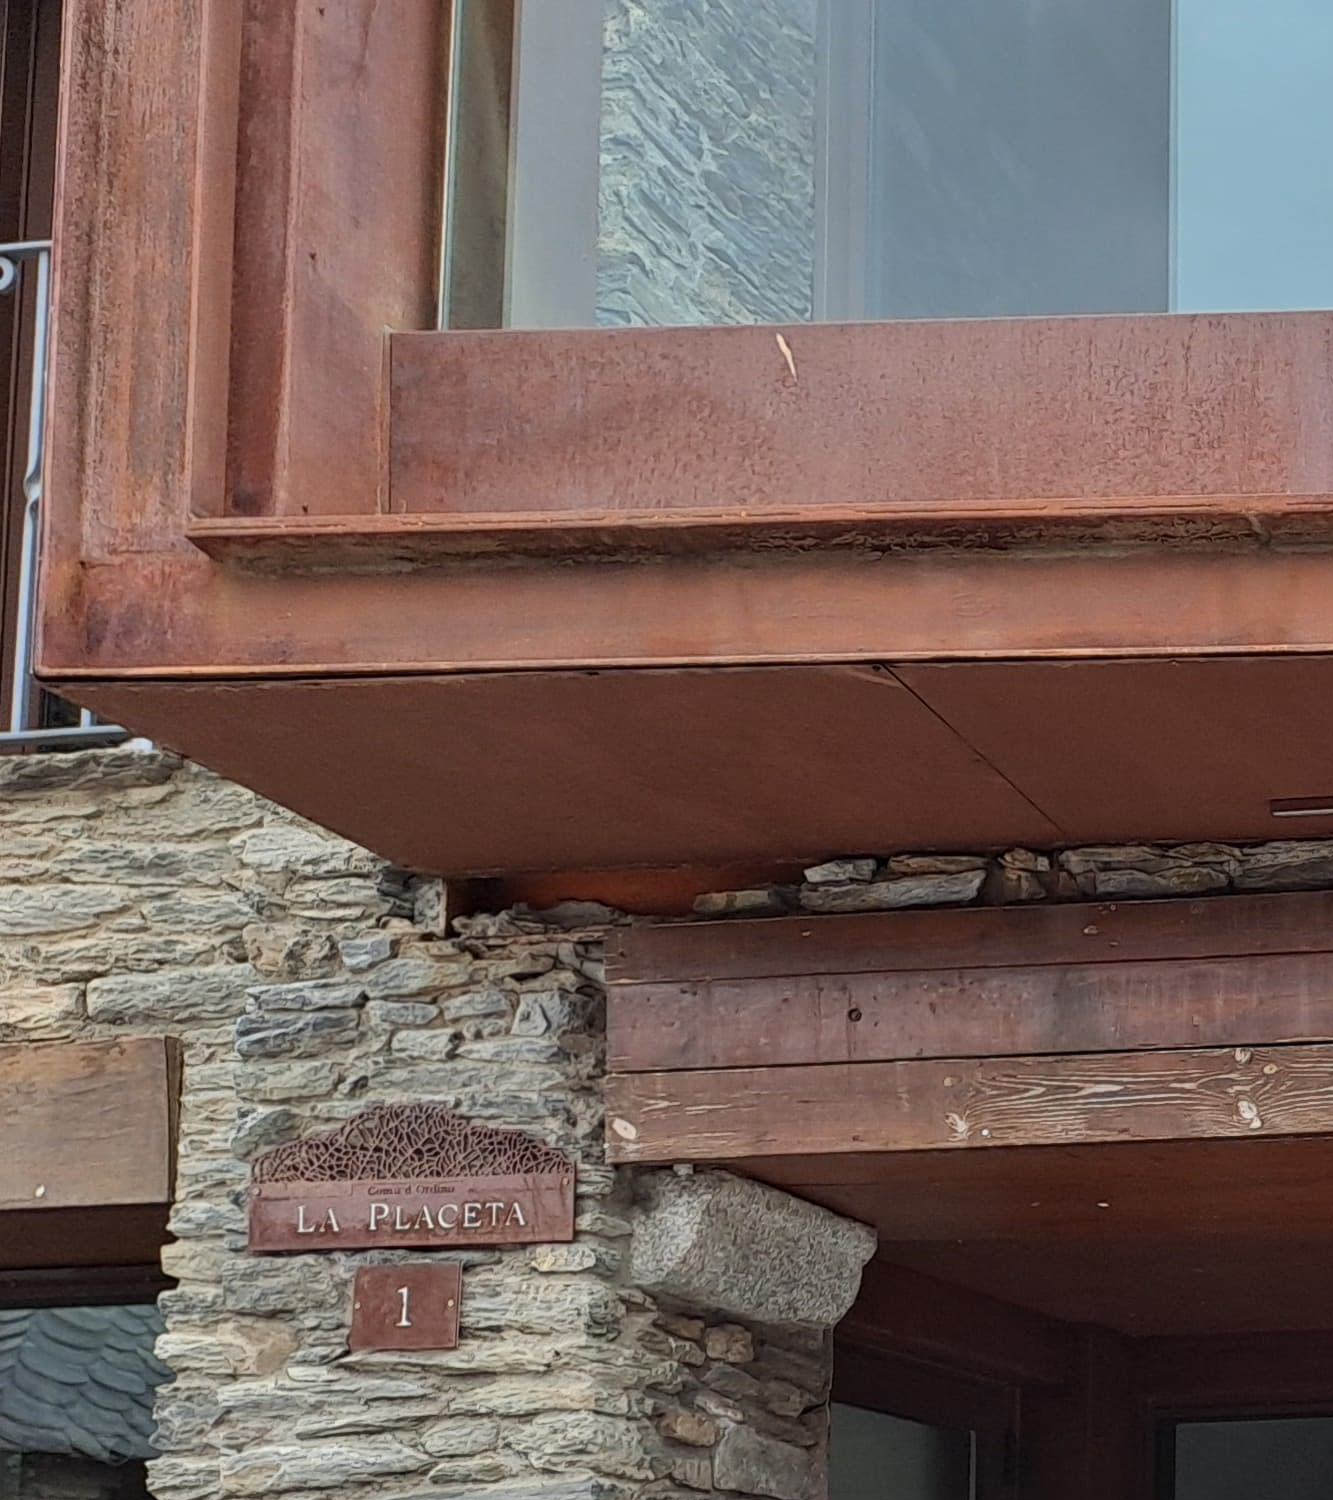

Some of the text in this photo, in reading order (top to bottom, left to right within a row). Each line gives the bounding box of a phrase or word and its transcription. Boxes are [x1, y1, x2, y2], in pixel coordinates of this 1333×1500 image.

[296, 1202, 526, 1233] LA PLACETA
[395, 1286, 412, 1327] 1
